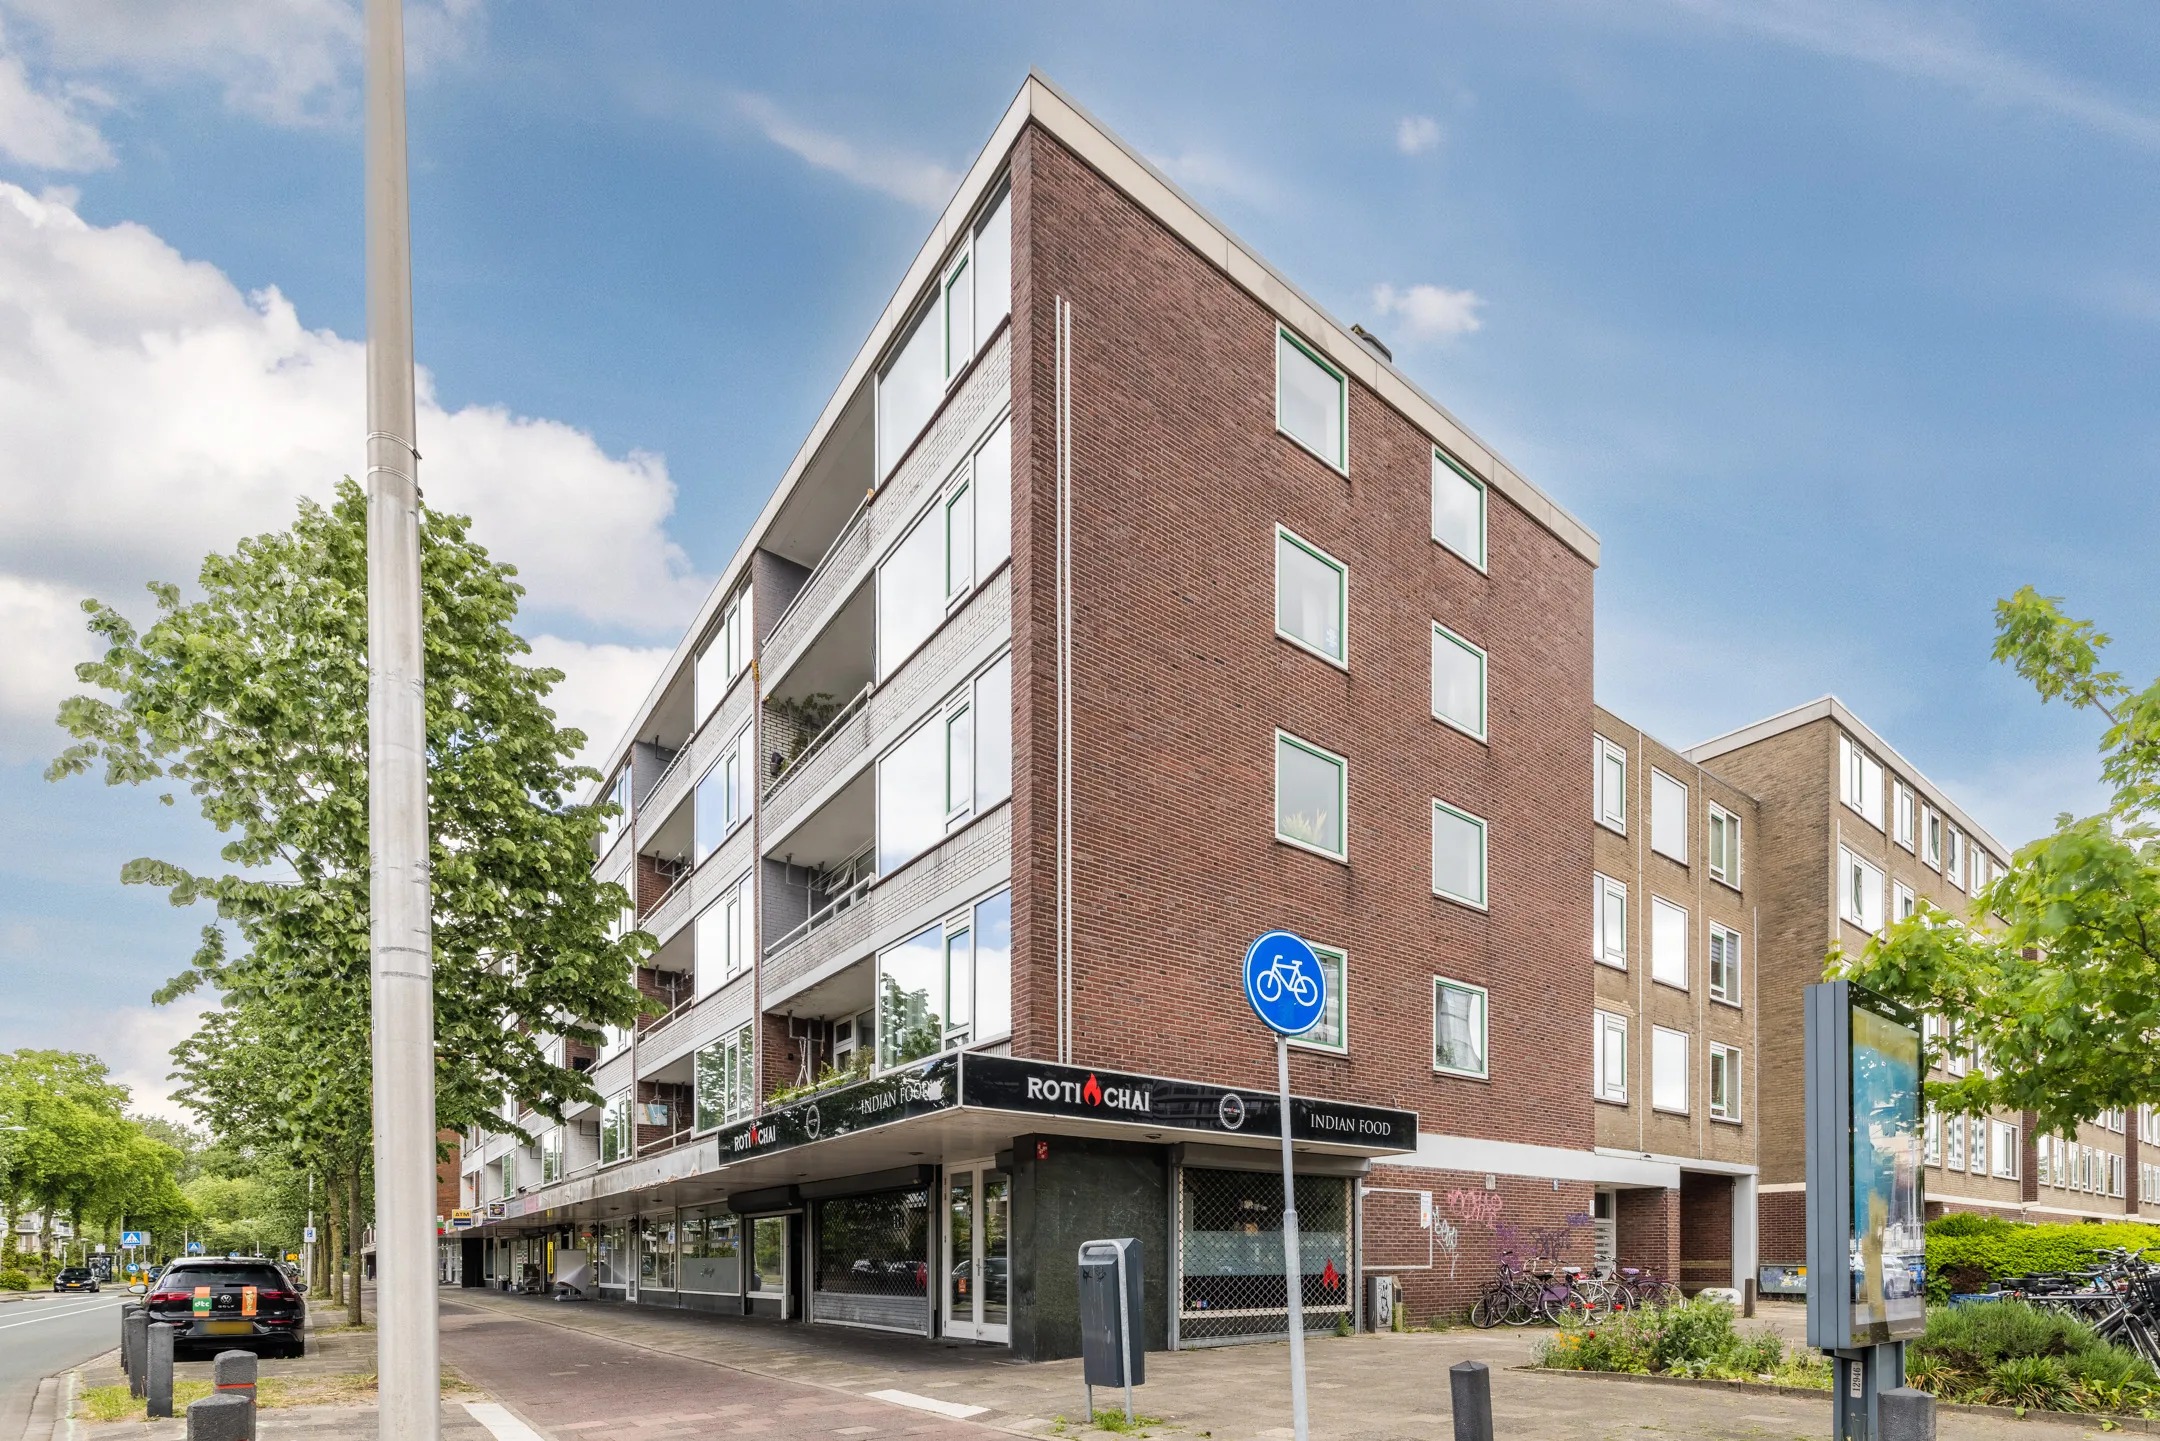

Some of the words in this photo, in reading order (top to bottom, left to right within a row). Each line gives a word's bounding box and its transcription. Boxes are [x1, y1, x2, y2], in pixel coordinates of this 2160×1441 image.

[861, 1089, 897, 1115] INDIAN
[1026, 1076, 1082, 1105] ROTI
[1103, 1087, 1151, 1112] CHAI
[1310, 1113, 1355, 1132] INDIAN
[1359, 1119, 1391, 1136] FOOD
[734, 1132, 752, 1152] ROTI
[758, 1125, 776, 1145] CHAI
[1852, 1367, 1862, 1392] 12946
